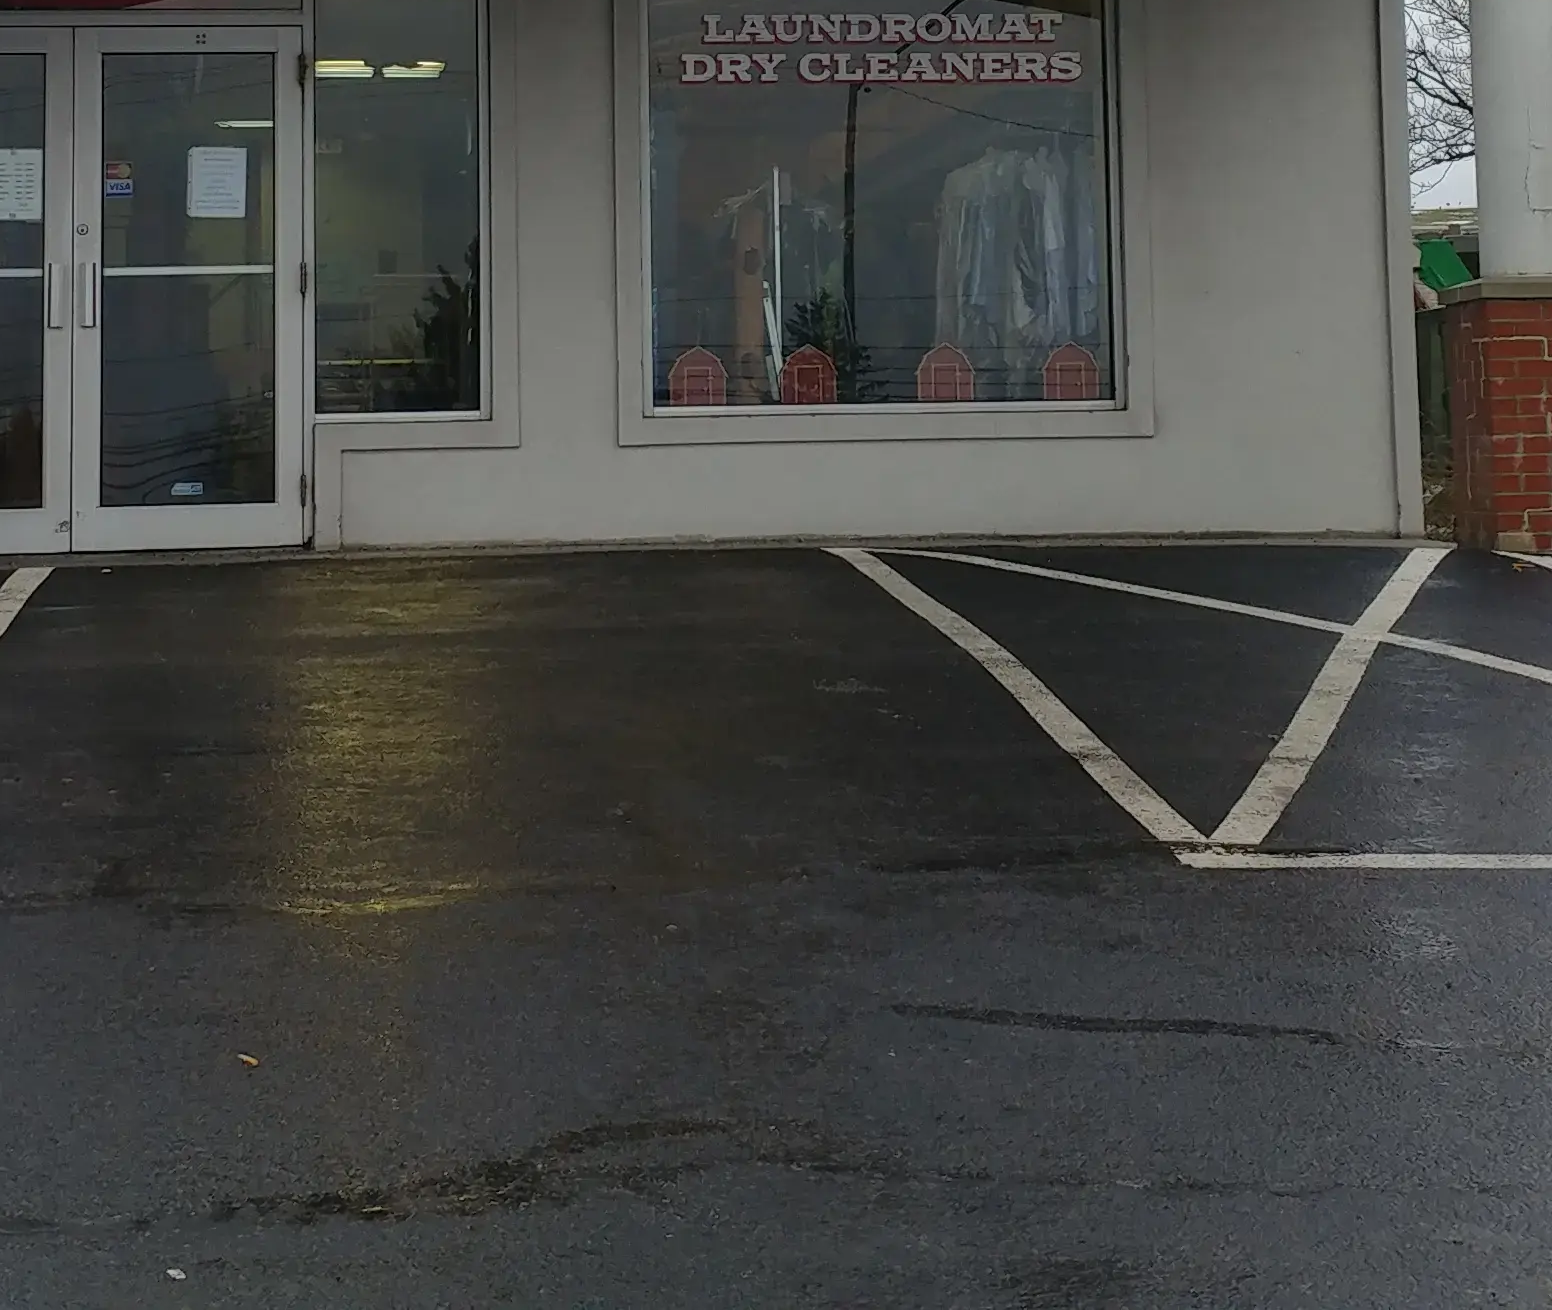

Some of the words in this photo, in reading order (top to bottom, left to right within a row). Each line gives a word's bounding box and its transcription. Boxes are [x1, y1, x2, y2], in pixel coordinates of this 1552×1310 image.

[701, 12, 1063, 44] LAUNDROMAT
[679, 52, 787, 84] DRY
[797, 50, 1083, 84] CLEANERS
[108, 181, 132, 191] VISA
